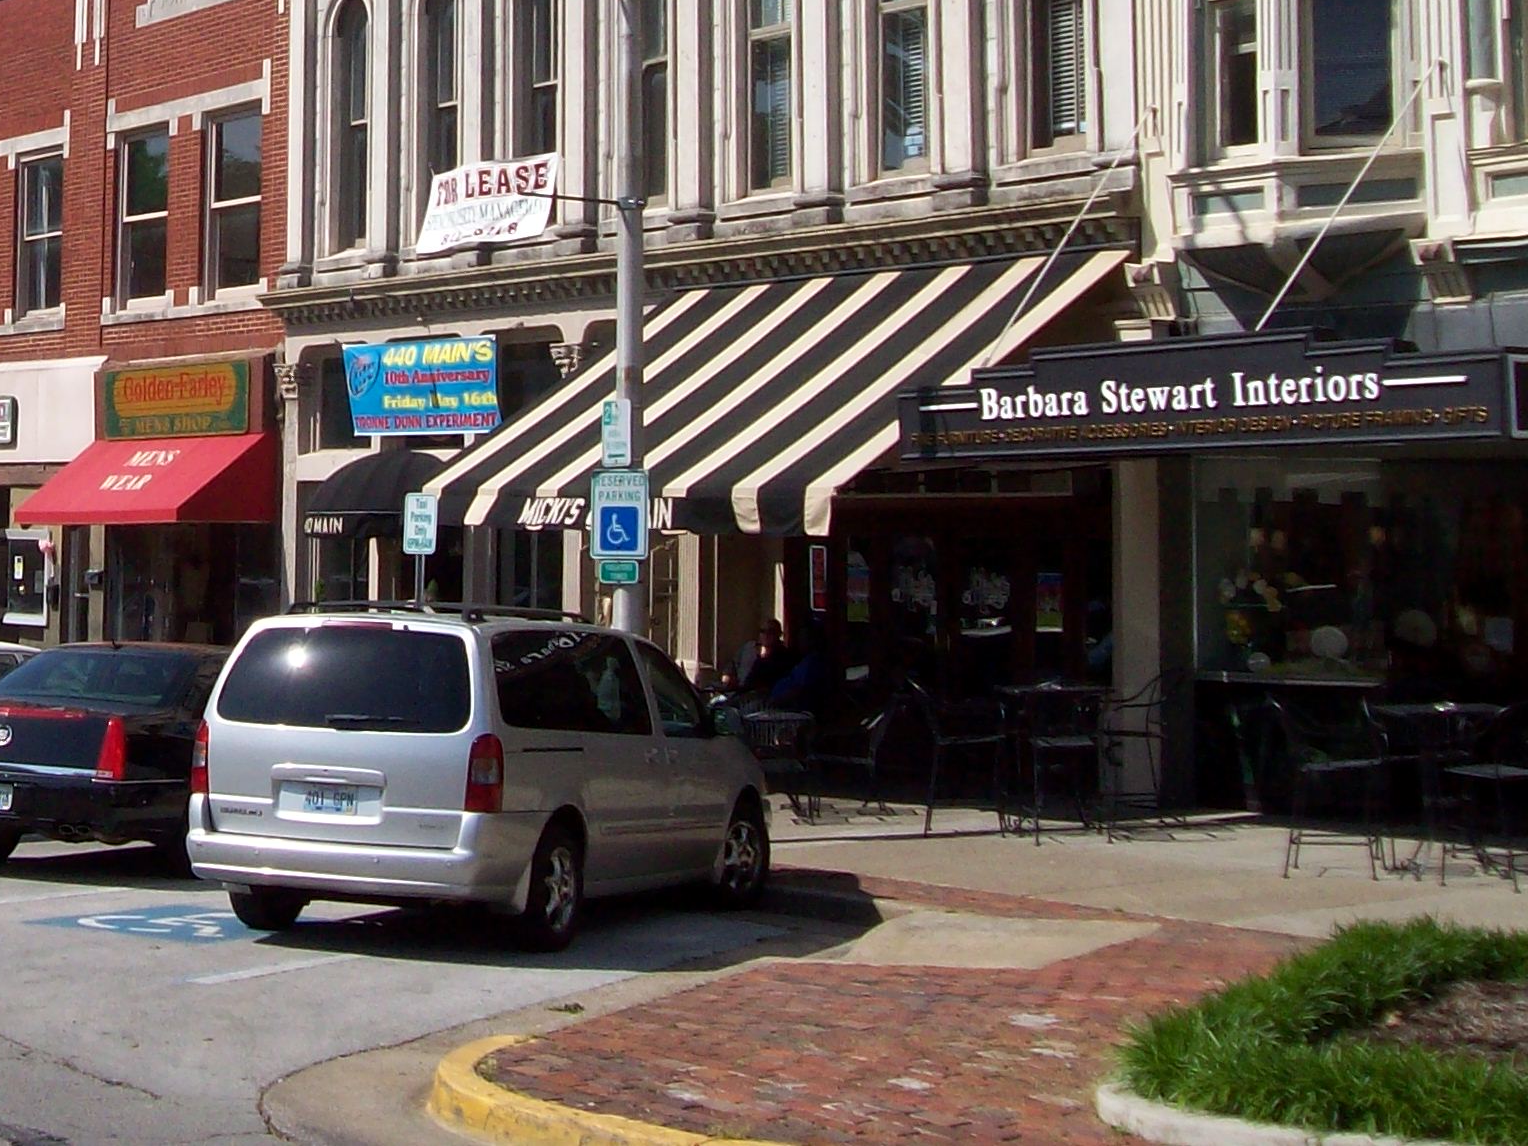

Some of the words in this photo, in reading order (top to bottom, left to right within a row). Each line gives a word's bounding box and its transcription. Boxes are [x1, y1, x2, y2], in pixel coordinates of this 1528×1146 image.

[436, 177, 458, 207] FOR
[464, 161, 548, 199] LEASE
[382, 345, 417, 366] 440
[422, 340, 493, 365] MAIN'S
[384, 370, 410, 385] 10th
[411, 368, 490, 384] Anniversary
[383, 394, 425, 410] Friday
[463, 391, 496, 406] 16th
[979, 384, 1090, 421] Barbara
[1100, 379, 1218, 415] Stewart
[1231, 365, 1381, 407] Interiors
[174, 415, 212, 432] SHOP
[426, 412, 497, 428] EXPERIMENT
[937, 429, 999, 445] FURNITURE
[1004, 425, 1077, 443] DECORATIVE
[1082, 421, 1169, 440] ACCESSORIES
[1175, 417, 1238, 436] INTERIOR
[1240, 414, 1294, 433] DESIGN
[1300, 410, 1361, 431] PICTURE
[1365, 408, 1433, 428] FRAMING
[1443, 405, 1489, 424] GIFTS
[98, 473, 153, 491] WEAR
[599, 474, 644, 487] ESERVED
[598, 490, 642, 502] PARKING
[314, 516, 343, 534] MAIN
[411, 511, 432, 525] Parking
